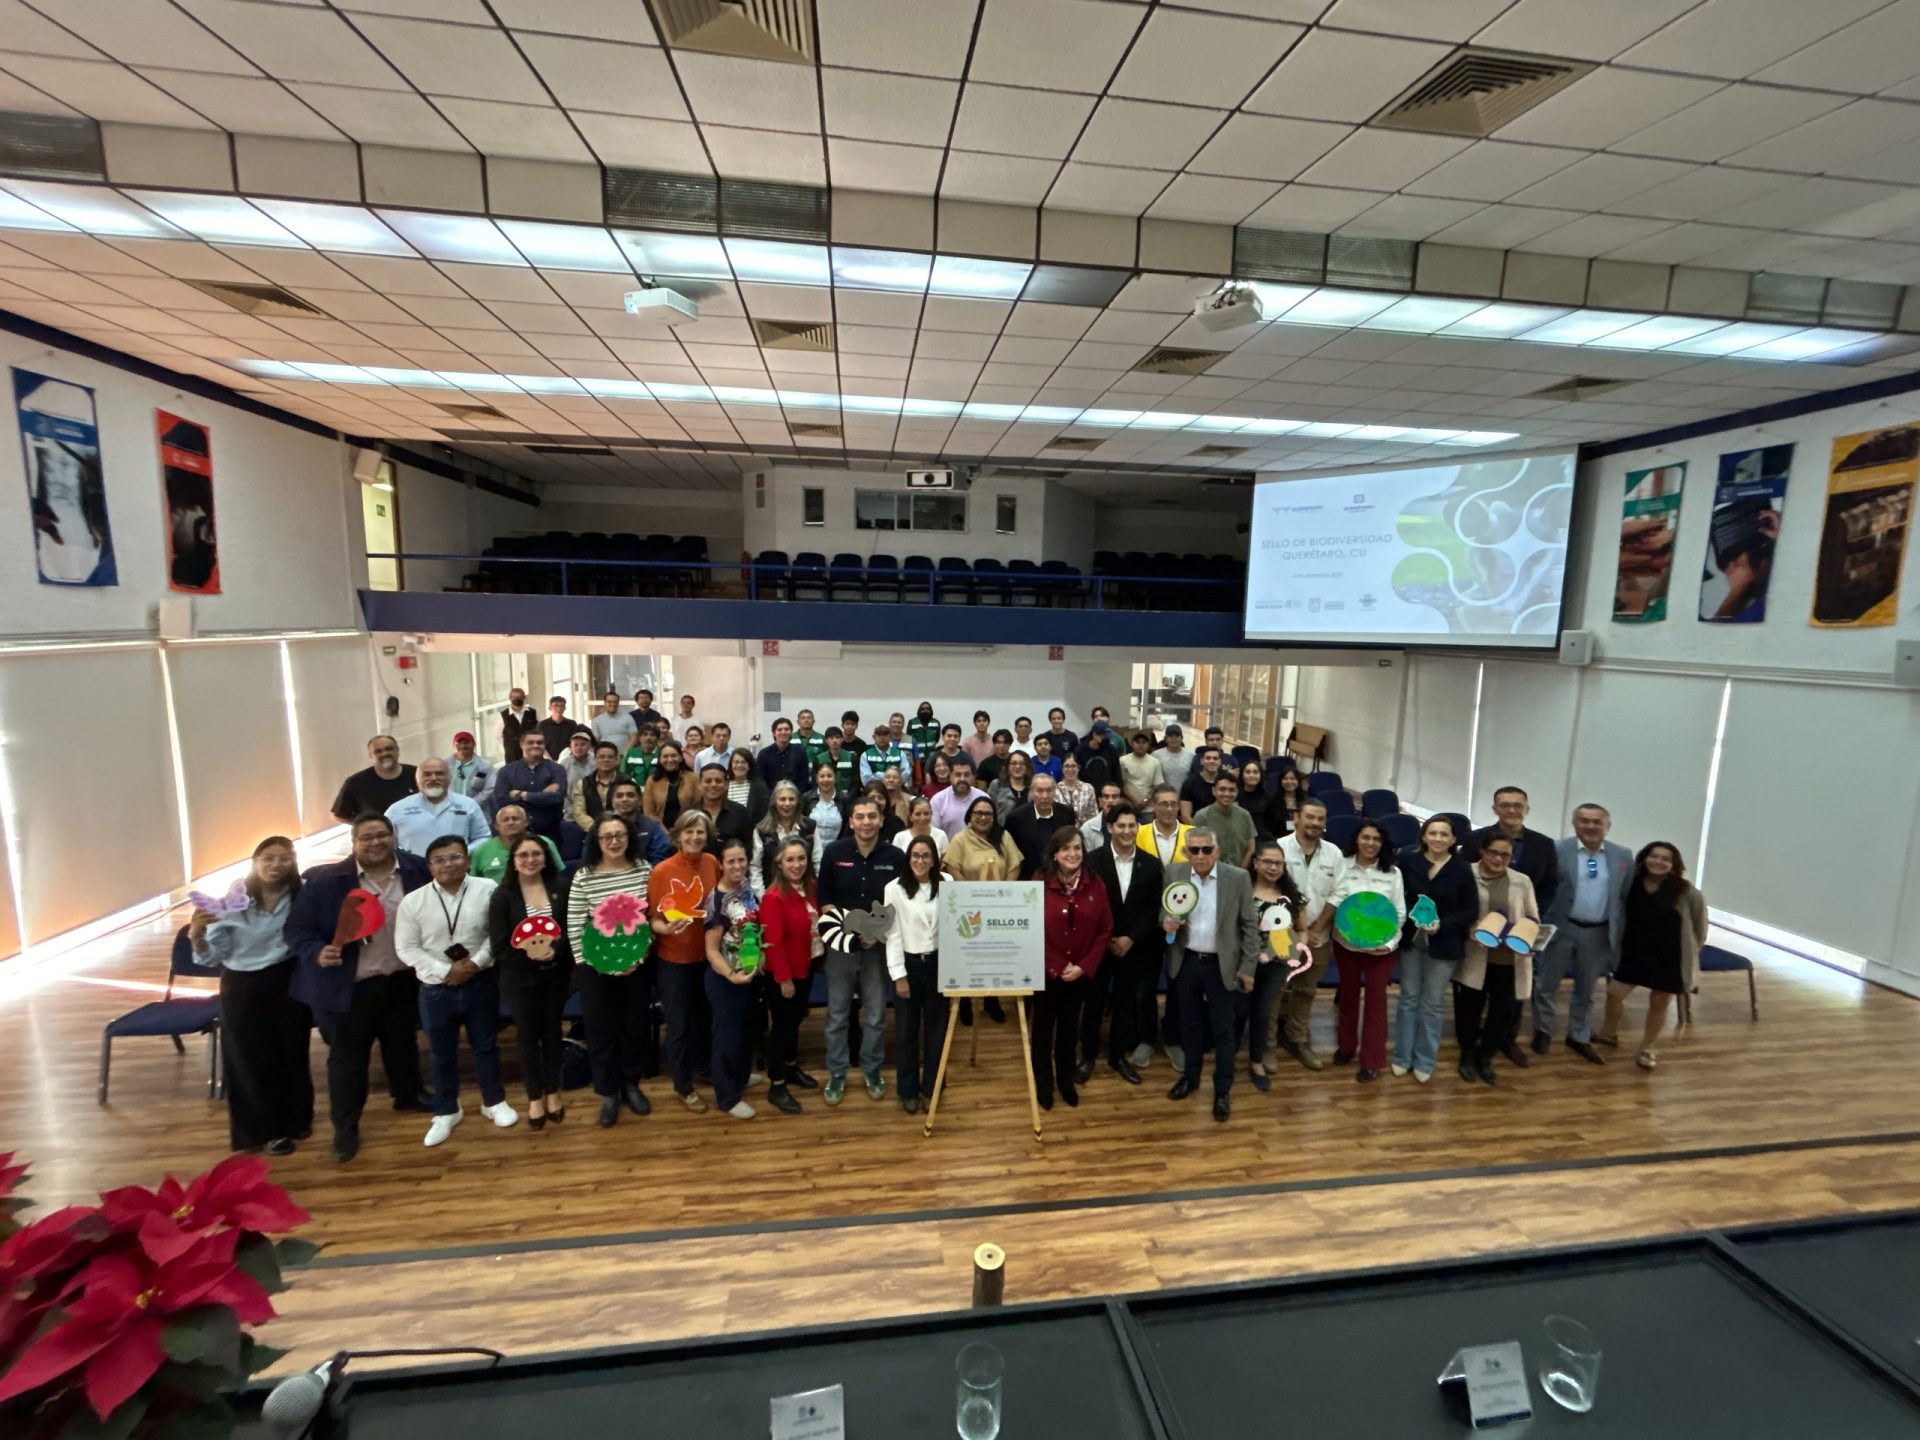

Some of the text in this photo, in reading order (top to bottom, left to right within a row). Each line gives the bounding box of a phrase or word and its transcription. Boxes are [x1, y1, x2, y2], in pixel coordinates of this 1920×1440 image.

[1261, 534, 1393, 549] SELLO DE BIODIVERSIDAD
[1282, 549, 1346, 560] QUERÉTARO,
